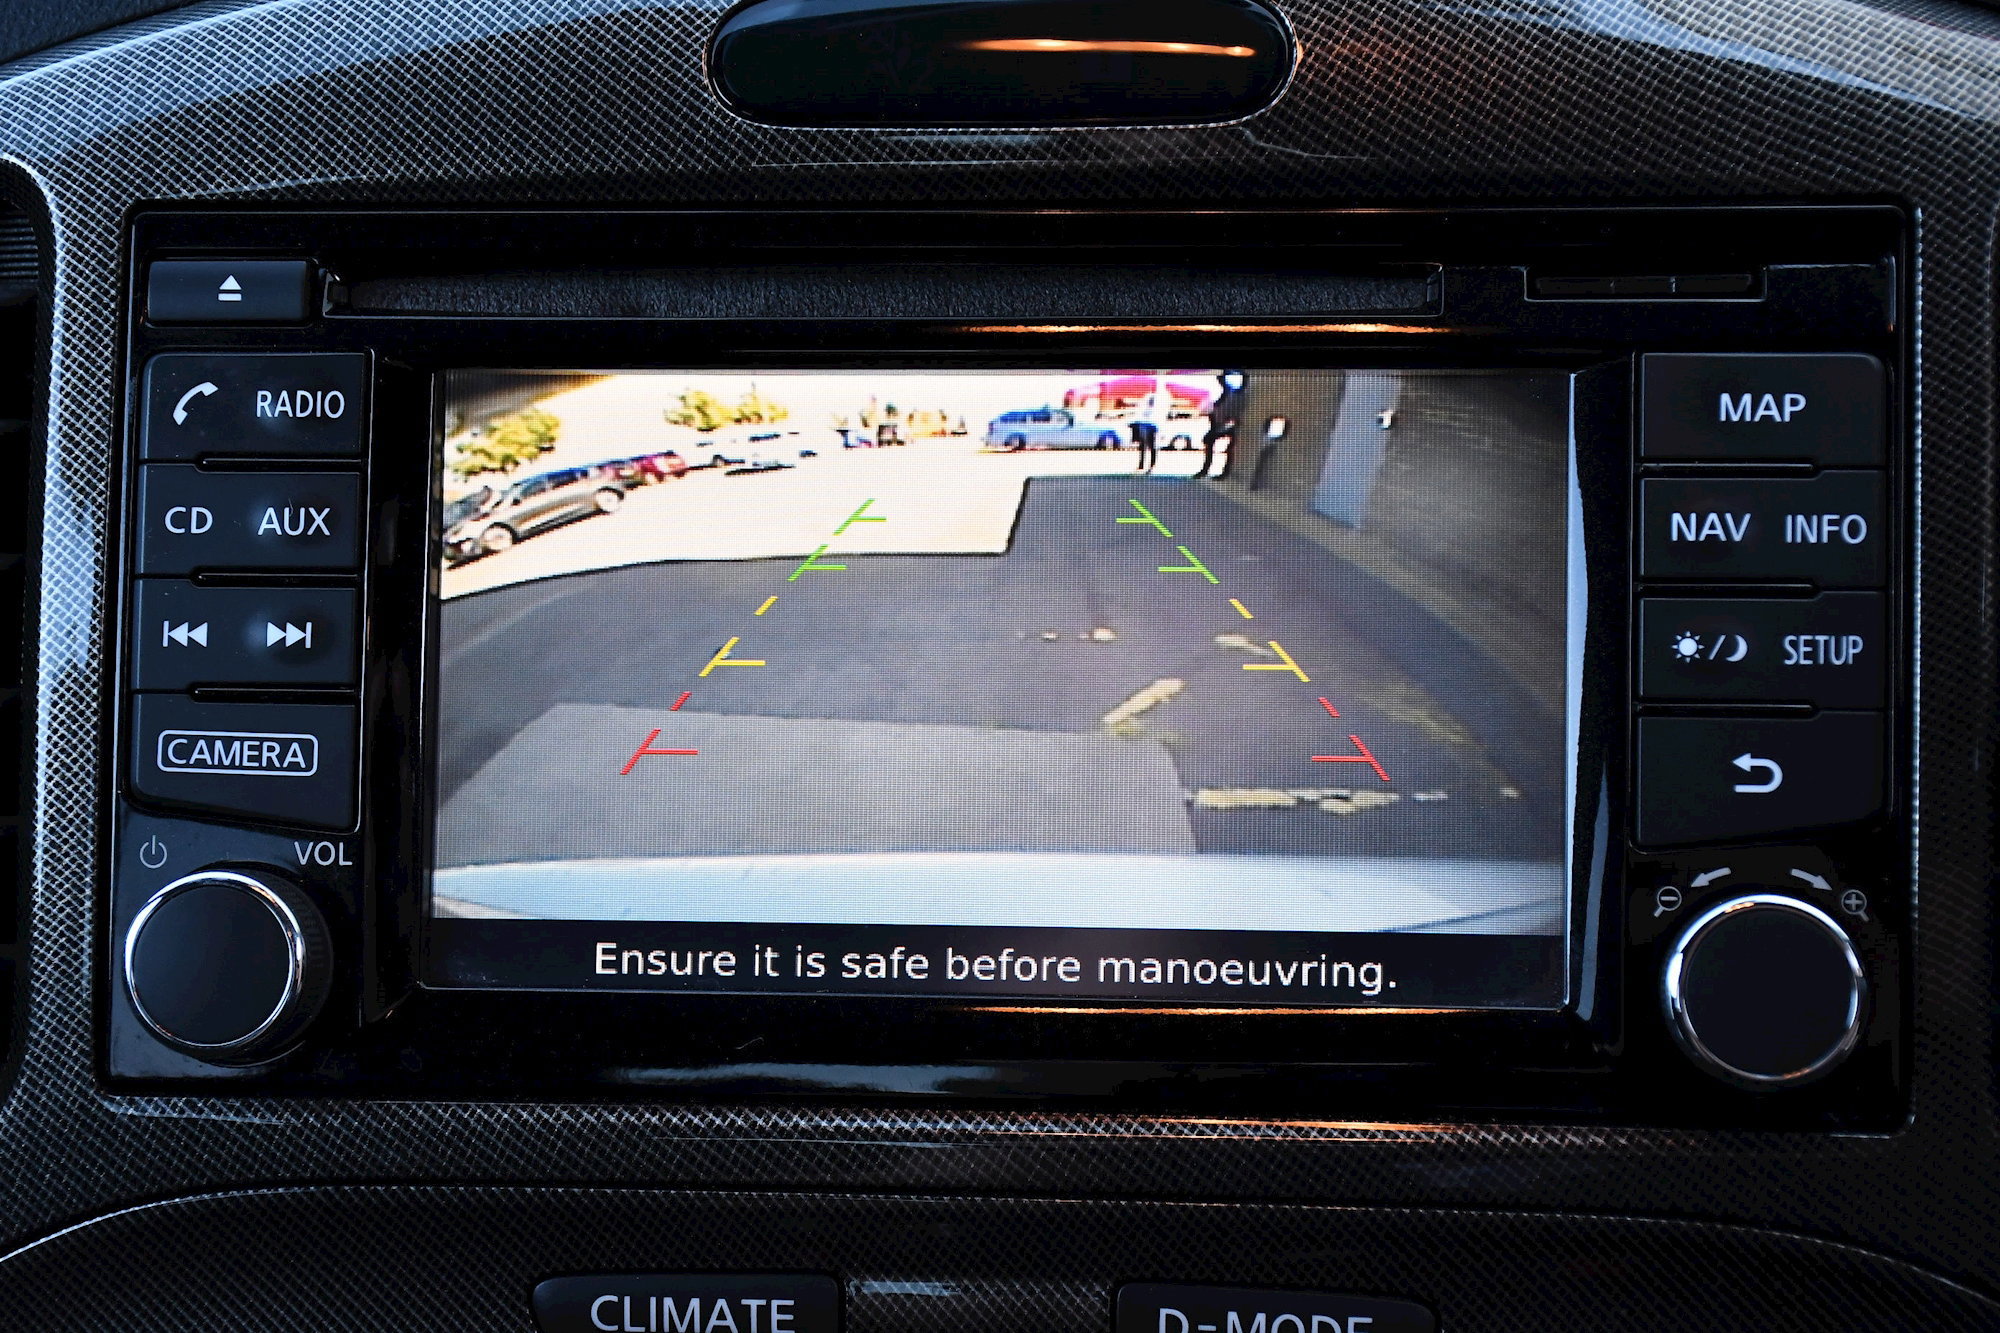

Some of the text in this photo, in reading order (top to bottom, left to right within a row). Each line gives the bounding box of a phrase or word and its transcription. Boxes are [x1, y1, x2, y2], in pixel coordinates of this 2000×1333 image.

[256, 389, 345, 419] RADIO
[1719, 392, 1807, 423] MAP
[164, 506, 213, 534] CD
[257, 506, 331, 536] AUX
[1670, 512, 1751, 542] NAV
[1785, 513, 1867, 544] INFO
[1783, 634, 1863, 666] SETUP
[167, 738, 306, 769] CAMERA
[293, 841, 353, 866] VOL
[595, 942, 1397, 997] Ensure it is safe before manoeuvring.
[590, 1294, 795, 1333] CLIMATE
